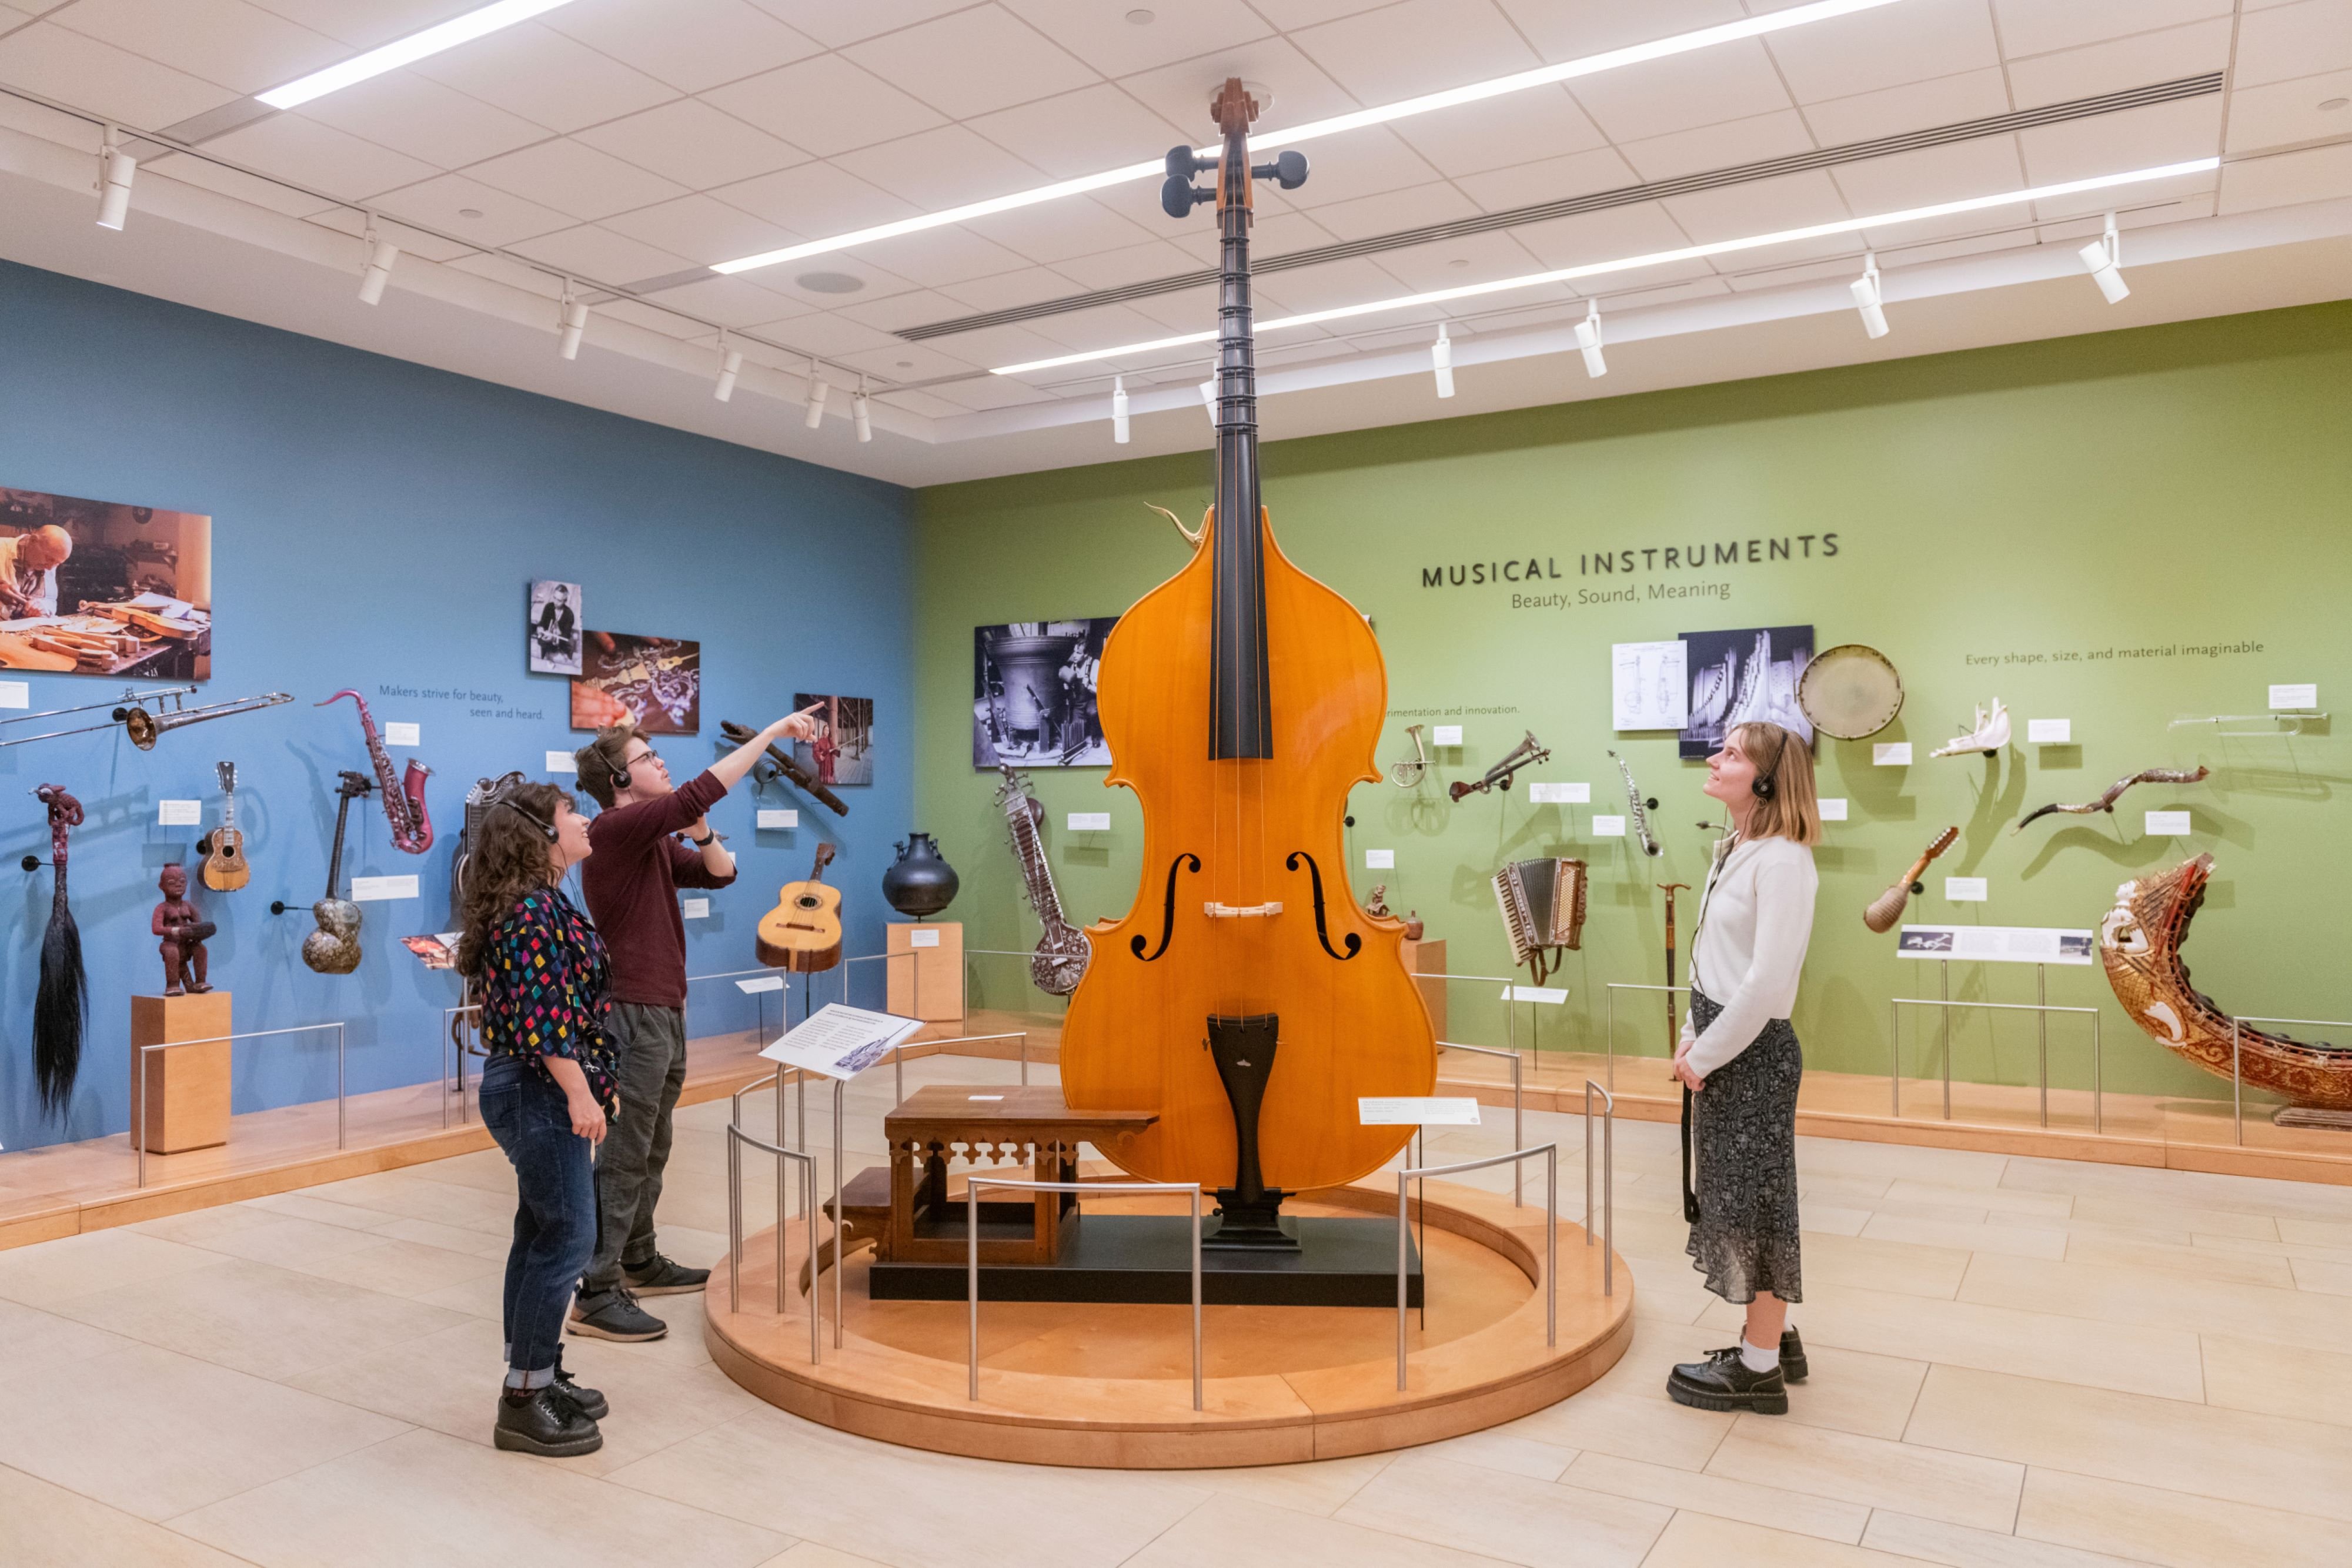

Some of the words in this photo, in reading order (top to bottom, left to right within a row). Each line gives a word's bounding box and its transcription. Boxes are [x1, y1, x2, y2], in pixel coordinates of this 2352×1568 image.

[1422, 557, 1562, 588] MUSICAL
[1581, 533, 1840, 576] INSTRUMENTS
[1511, 591, 1572, 610] Beauty,
[1578, 585, 1641, 604] Sound,
[1648, 580, 1731, 600] Meaning
[1965, 653, 1999, 667] Every
[2003, 651, 2047, 666] shape,
[2052, 649, 2083, 663] size,
[2087, 647, 2113, 660] and
[2118, 644, 2176, 658] material
[2181, 641, 2264, 658] imaginable
[379, 685, 418, 698] Makers
[422, 688, 449, 699] strive
[453, 689, 467, 700] for
[470, 690, 503, 704] beauty,
[470, 708, 492, 717] seen
[495, 708, 513, 718] and
[516, 708, 544, 720] heard.
[1385, 707, 1441, 717] rimentation
[1444, 706, 1462, 716] and
[1465, 705, 1520, 715] innovation.
